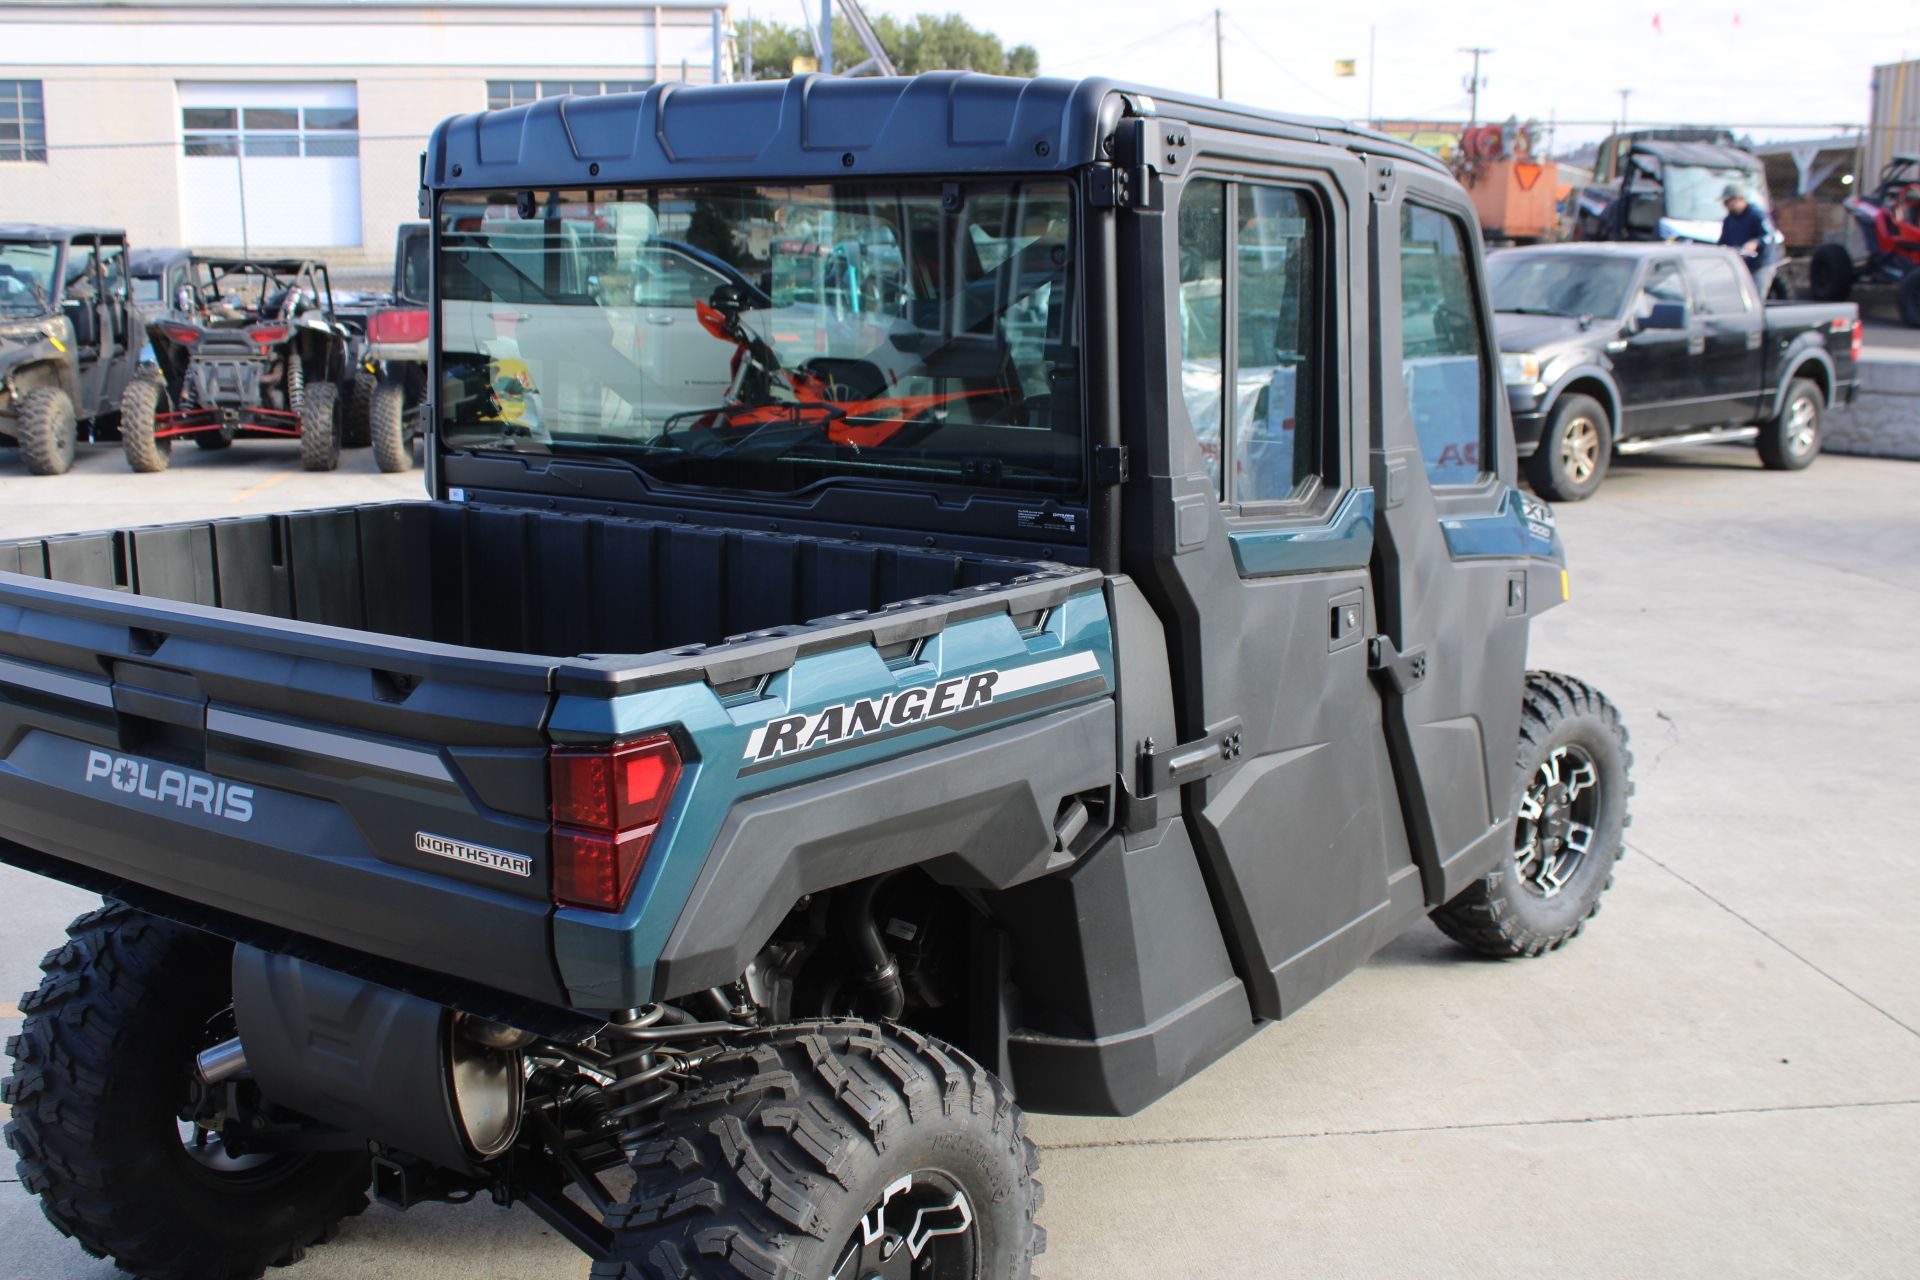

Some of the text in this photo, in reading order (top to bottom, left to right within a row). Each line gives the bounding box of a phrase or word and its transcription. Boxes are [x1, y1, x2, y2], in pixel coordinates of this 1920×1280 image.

[753, 670, 999, 762] RANGER
[85, 750, 255, 823] POLARIS
[420, 837, 525, 873] NORTHSTAR
